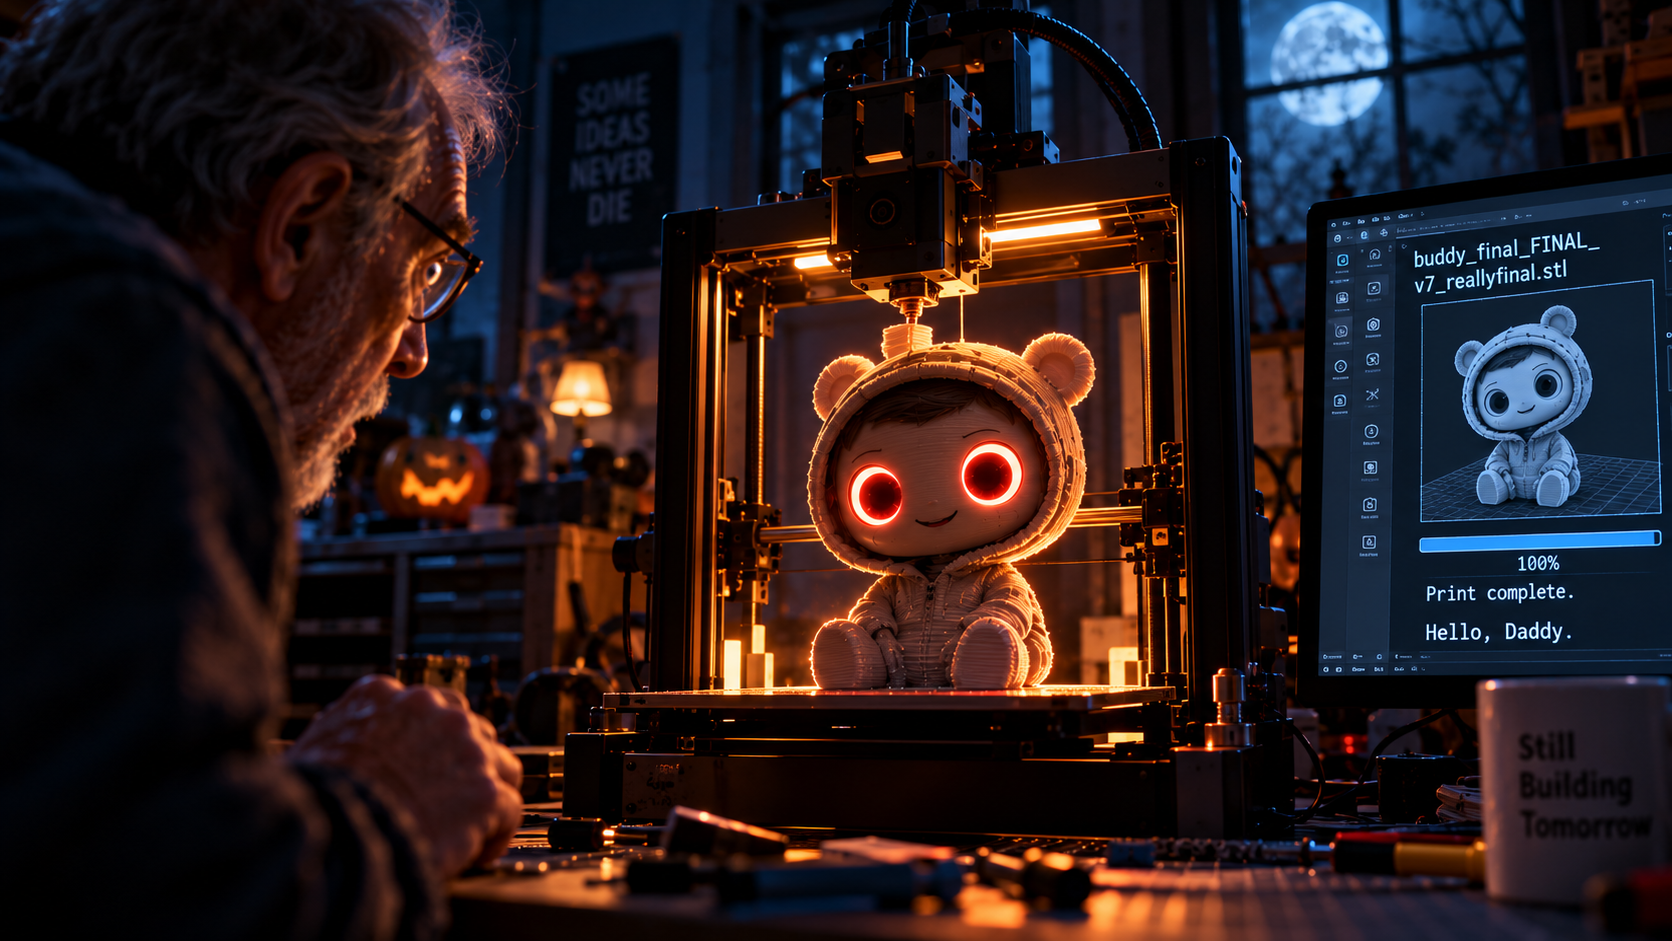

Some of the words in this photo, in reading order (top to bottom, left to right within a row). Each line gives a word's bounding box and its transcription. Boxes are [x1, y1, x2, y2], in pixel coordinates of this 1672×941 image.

[576, 71, 651, 117] SOME
[575, 110, 652, 154] IDEAS
[569, 147, 654, 192] NEVER
[586, 188, 633, 227] DIE
[1414, 231, 1600, 268] buddy_final_FINAL_
[1414, 258, 1567, 294] v7_reallyfinal.stl
[1518, 555, 1560, 571] 100%
[1426, 585, 1476, 602] Print
[1487, 582, 1574, 604] complete.
[1425, 623, 1491, 644] Hello,
[1505, 621, 1573, 644] Daddy.
[1519, 730, 1575, 760] Still
[1520, 771, 1632, 807] Building
[1520, 809, 1652, 838] Tomorrow
